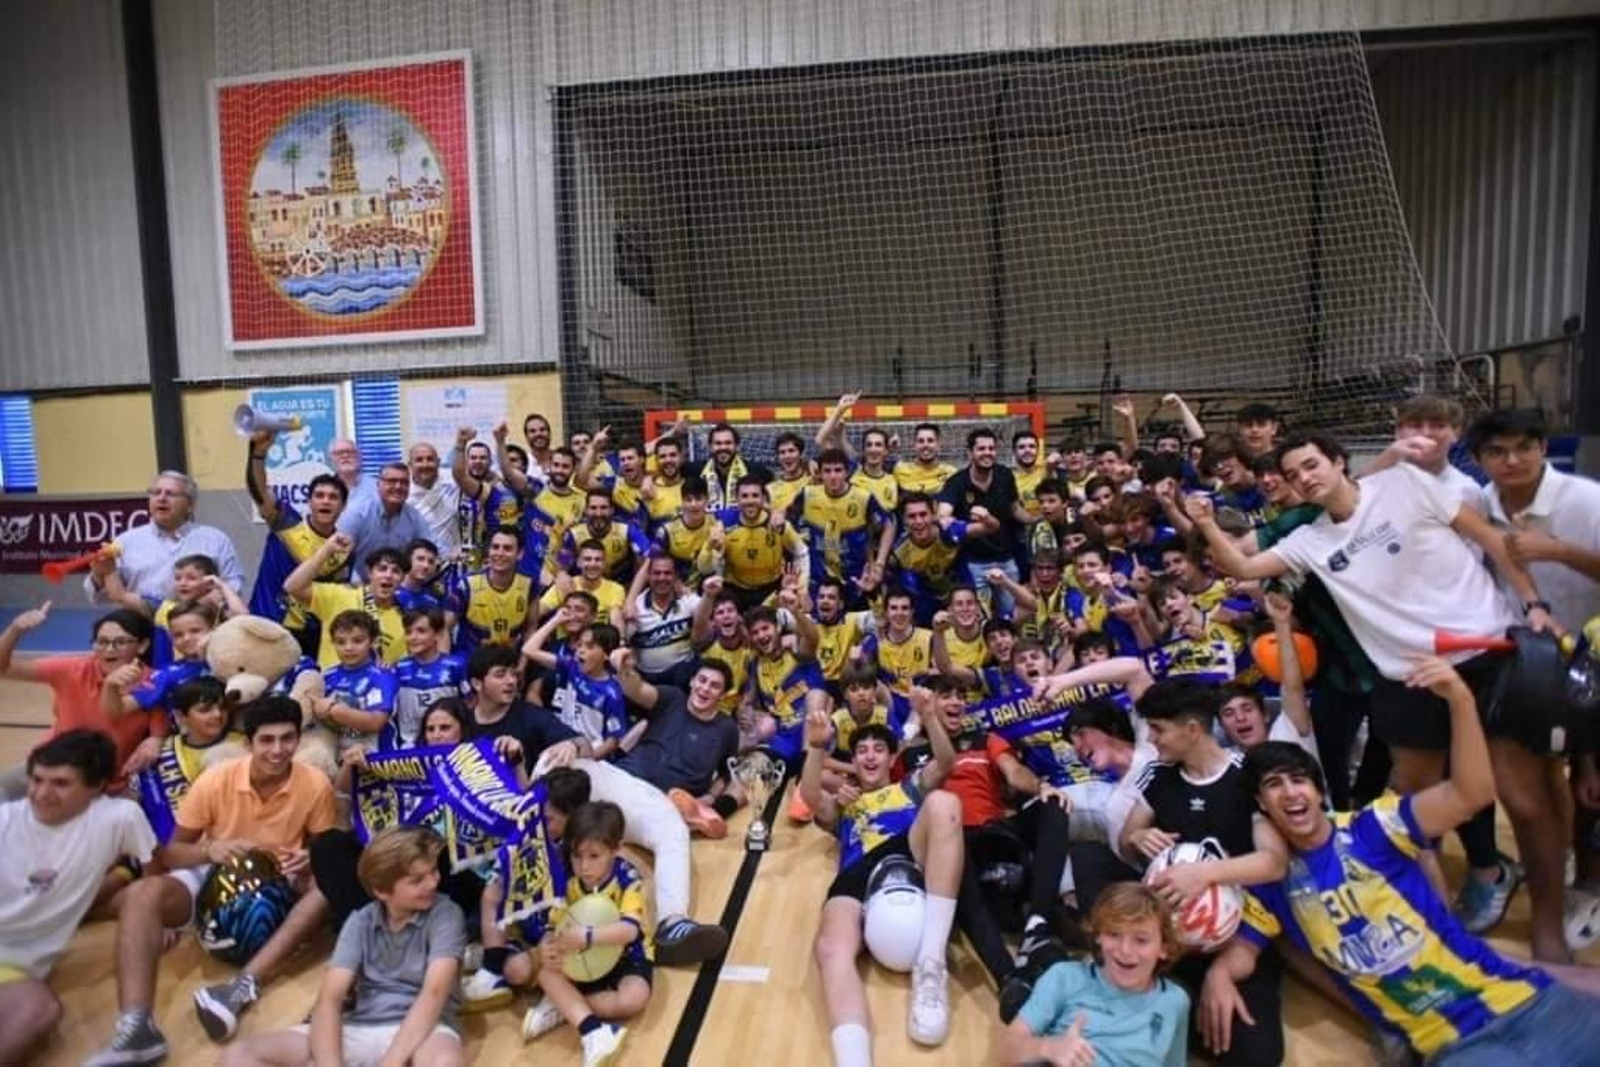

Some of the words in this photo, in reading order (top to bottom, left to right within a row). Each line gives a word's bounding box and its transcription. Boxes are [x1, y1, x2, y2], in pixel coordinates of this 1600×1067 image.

[272, 400, 298, 411] AGUA
[300, 399, 315, 410] ES
[317, 399, 331, 409] TU
[38, 510, 149, 543] IMDEC
